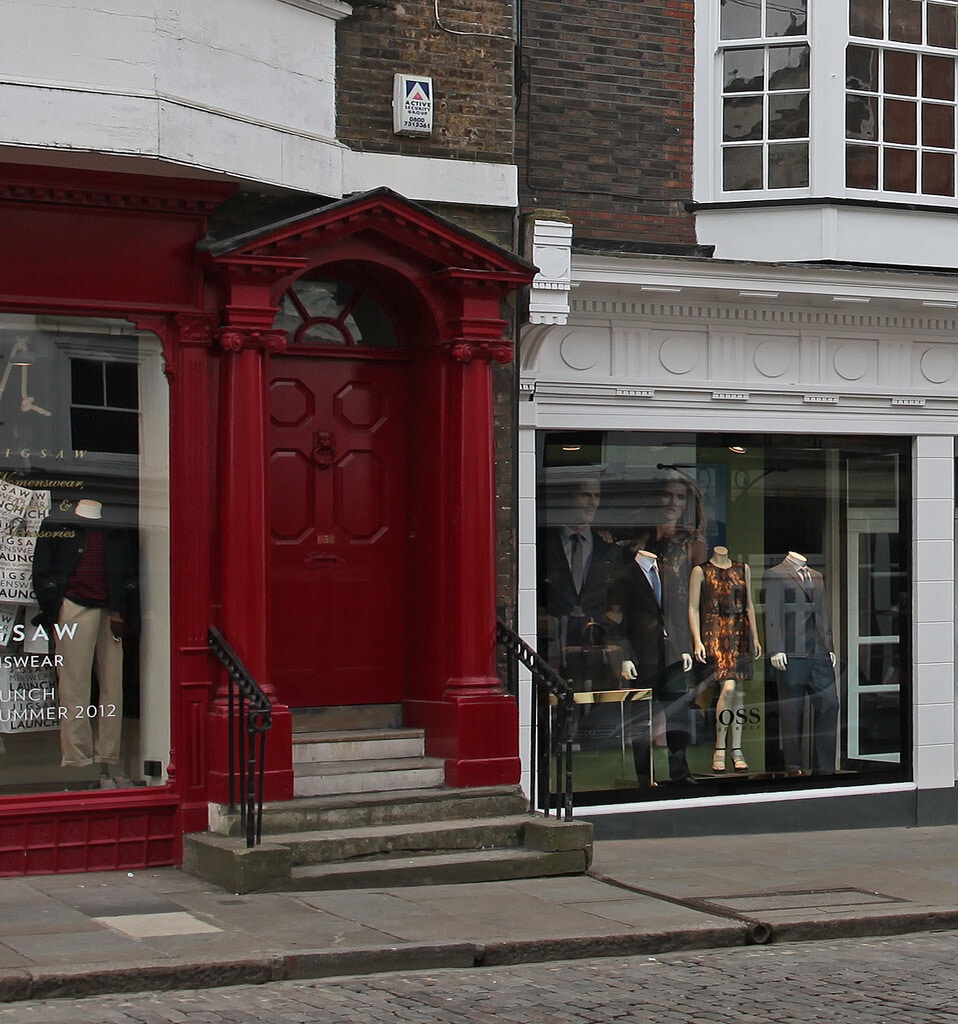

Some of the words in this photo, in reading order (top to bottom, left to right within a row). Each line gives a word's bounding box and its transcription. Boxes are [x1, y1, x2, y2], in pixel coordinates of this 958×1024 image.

[0, 623, 78, 642] SAW
[0, 655, 64, 668] SWEAR
[75, 704, 116, 719] 2012
[718, 708, 760, 725] OSS
